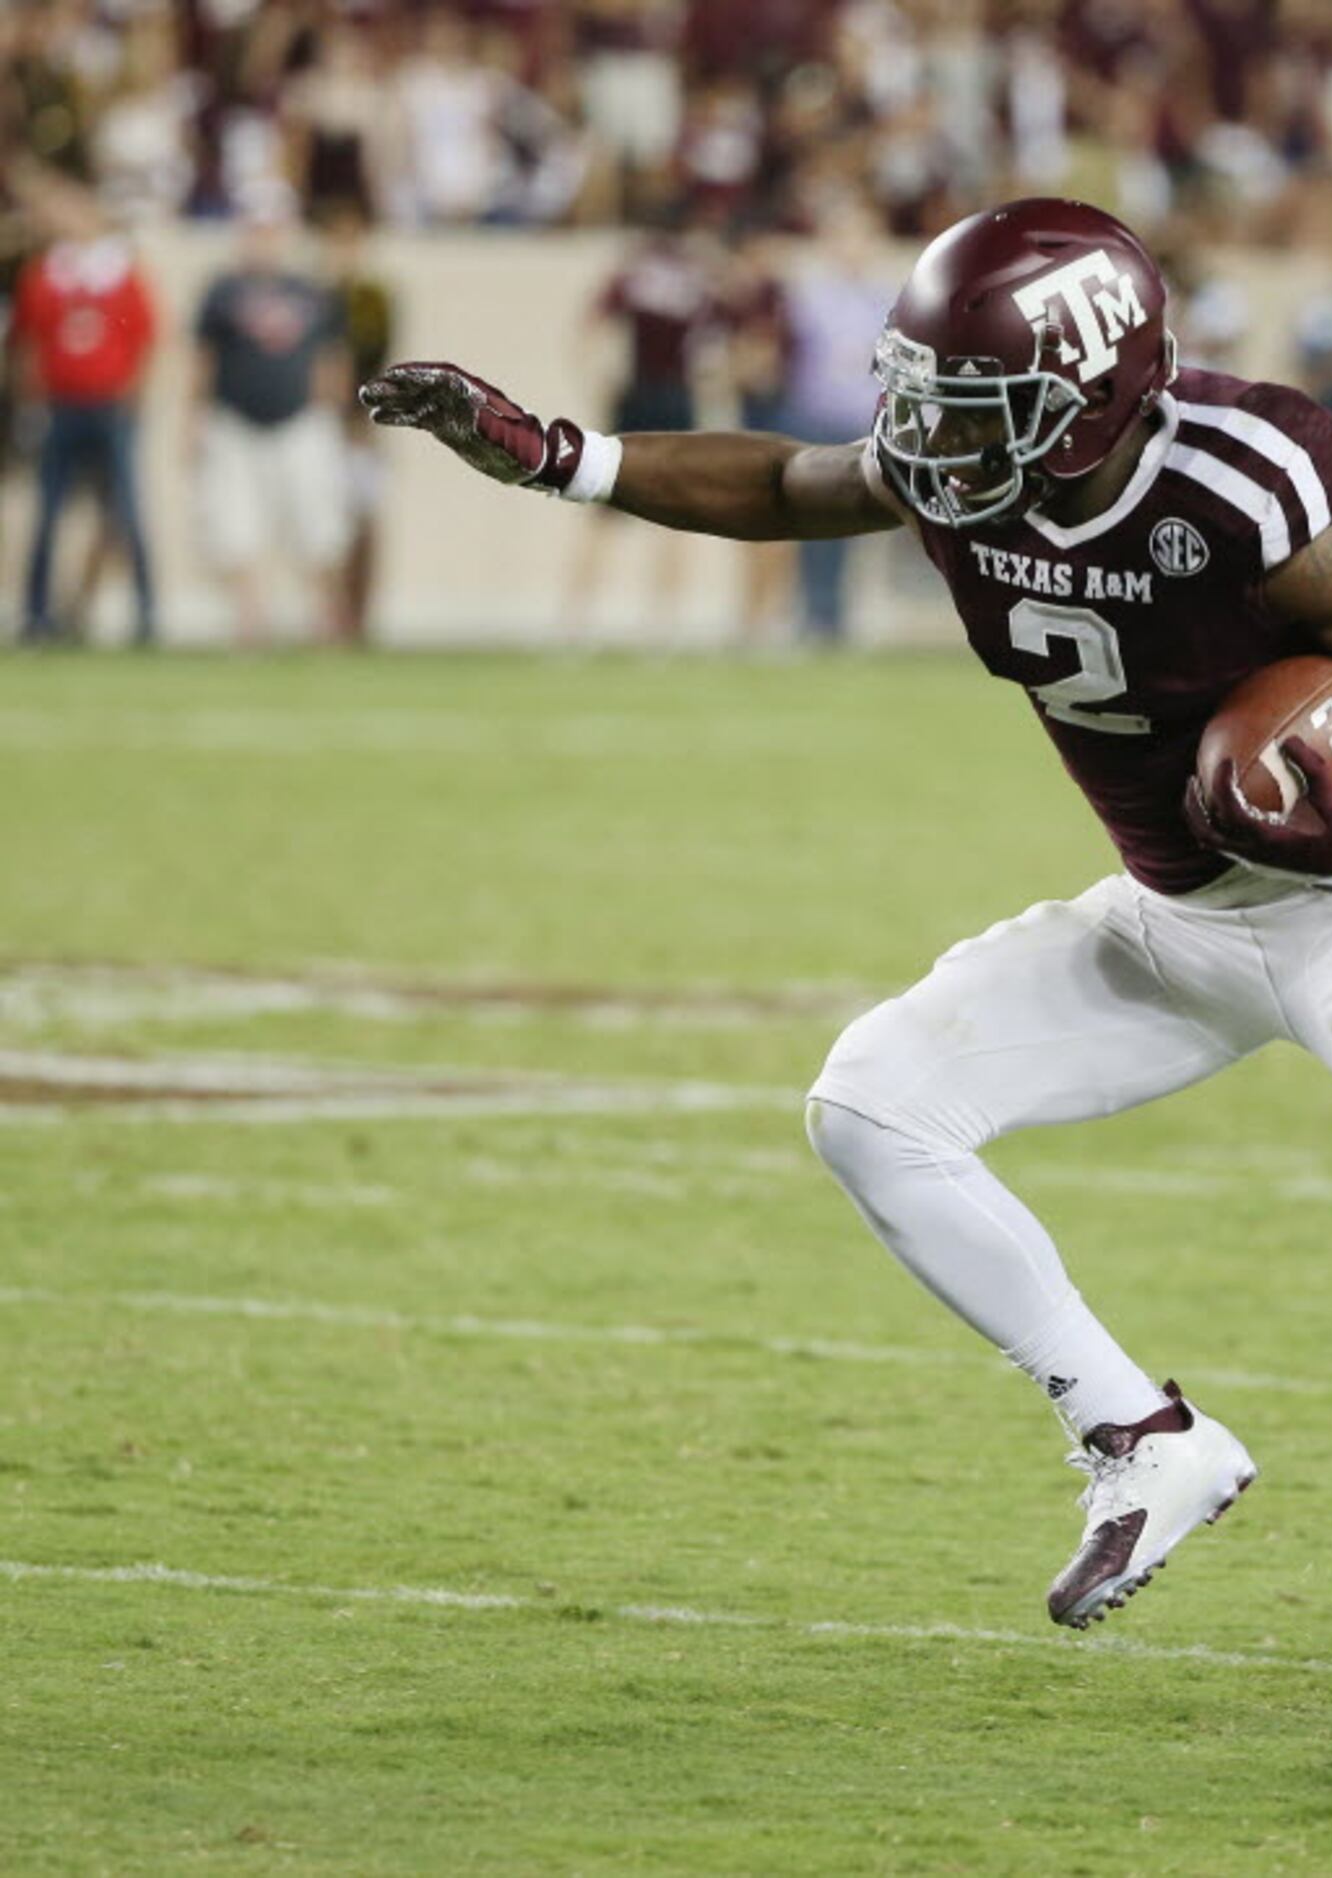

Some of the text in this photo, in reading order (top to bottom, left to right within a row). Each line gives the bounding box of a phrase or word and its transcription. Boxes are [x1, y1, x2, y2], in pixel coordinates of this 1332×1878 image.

[970, 541, 1153, 604] TEXAS A&M
[1154, 524, 1202, 572] SEC
[1009, 598, 1151, 734] 2
